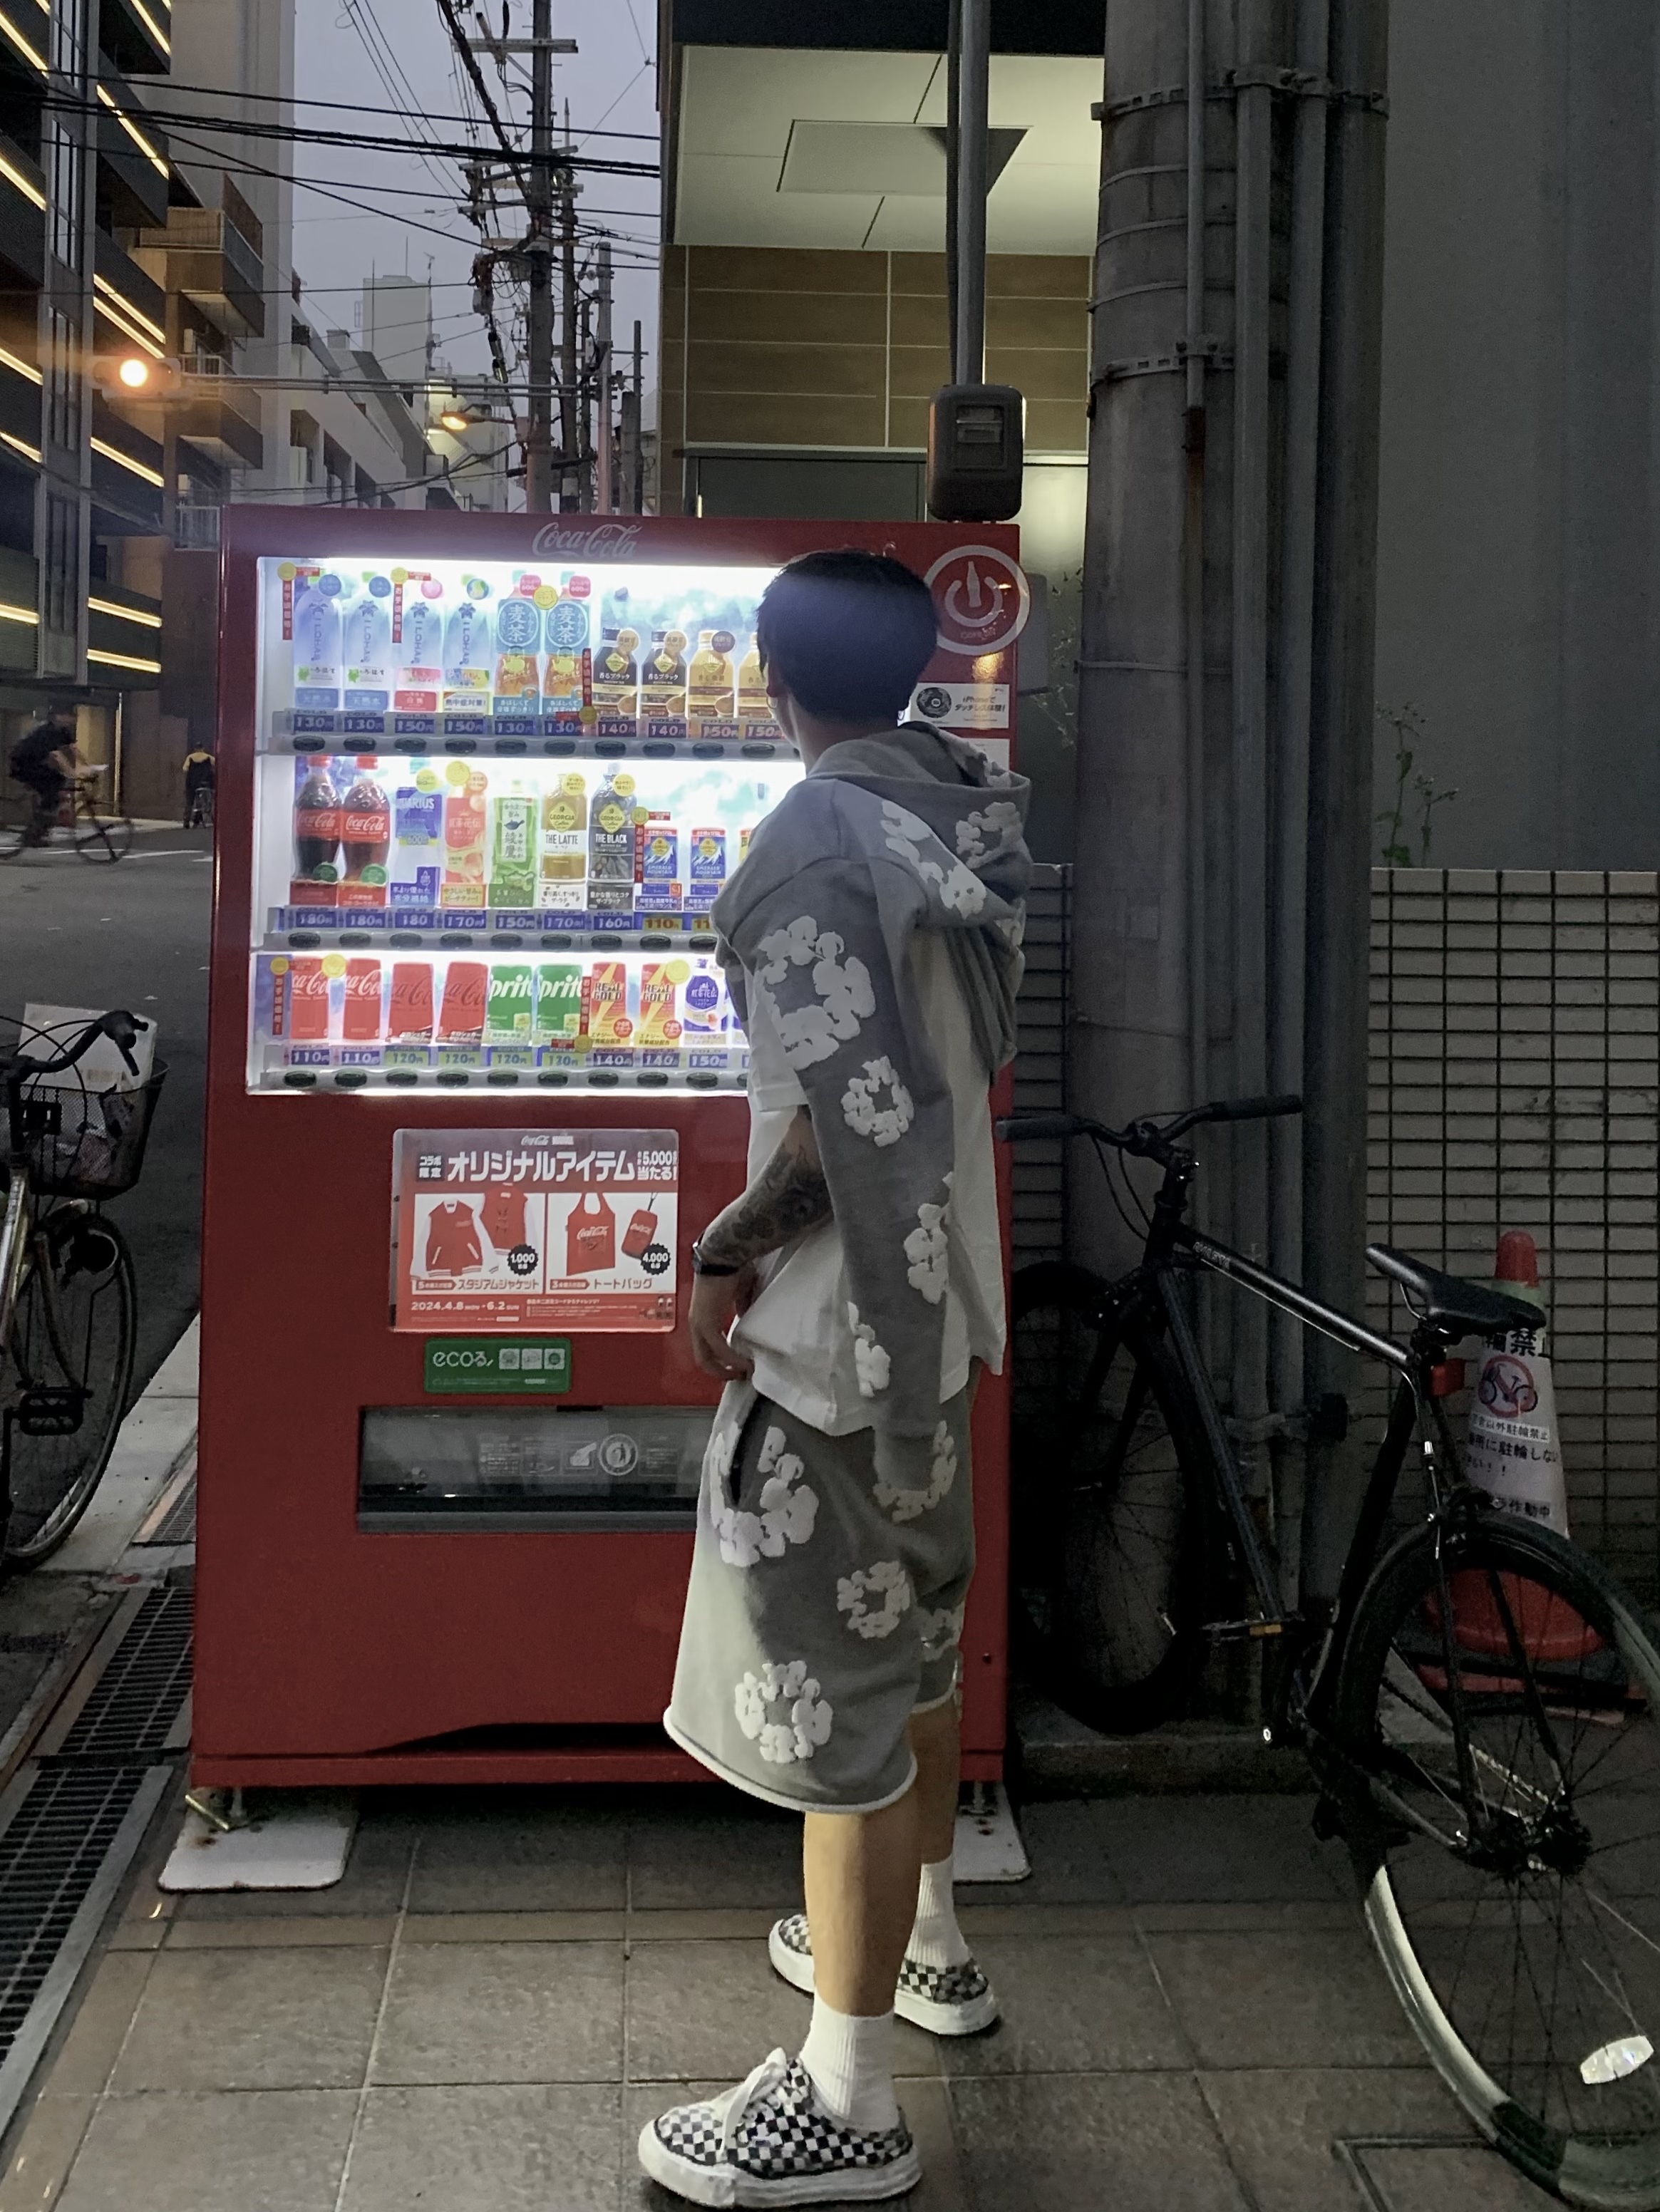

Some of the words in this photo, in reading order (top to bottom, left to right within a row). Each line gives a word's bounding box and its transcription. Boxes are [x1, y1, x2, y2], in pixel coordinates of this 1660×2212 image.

[532, 522, 642, 559] Coca-Cola
[507, 604, 527, 642] 麦茶
[557, 605, 576, 643] 麦茶
[346, 815, 386, 832] Coca-Cola
[545, 834, 557, 844] THE
[558, 834, 579, 844] LATTE
[595, 833, 606, 844] THE
[606, 834, 627, 844] BLACK
[403, 914, 428, 925] 180
[599, 917, 630, 928] 160円
[594, 980, 622, 991] REAL
[644, 982, 670, 993] REAL
[594, 991, 622, 1001] GOLD
[643, 992, 671, 1002] GOLD
[393, 1053, 423, 1064] 120円
[445, 1053, 475, 1064] 120円
[498, 1054, 527, 1065] 120円
[419, 1155, 442, 1167] コラボ
[448, 1150, 636, 1182] オリジナルアイテム
[419, 1167, 442, 1178] 限定
[637, 1167, 677, 1181] 当たる!
[577, 1226, 609, 1240] Coca-Cola
[458, 1278, 540, 1290] スタジアムジャケット
[594, 1278, 652, 1289] トートバッグ
[411, 1301, 464, 1311] 2024.4.8
[487, 1301, 505, 1311] 6.2
